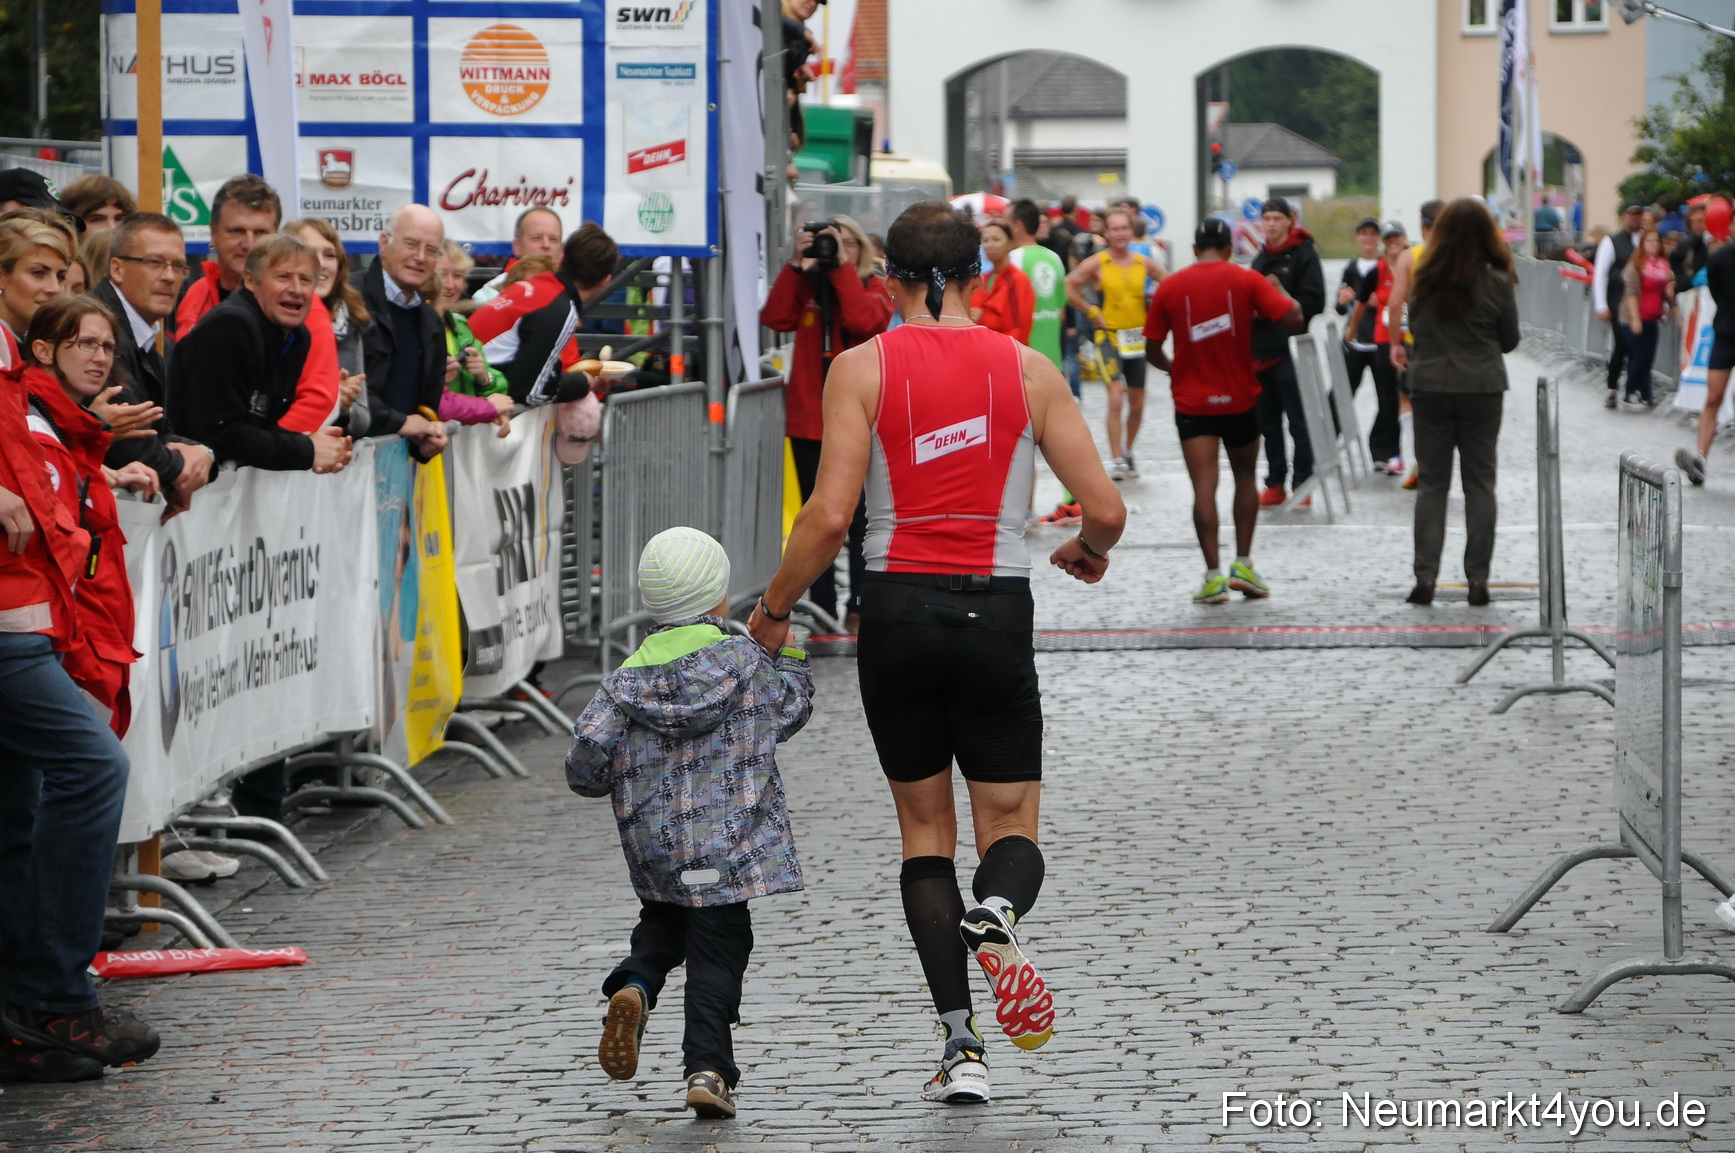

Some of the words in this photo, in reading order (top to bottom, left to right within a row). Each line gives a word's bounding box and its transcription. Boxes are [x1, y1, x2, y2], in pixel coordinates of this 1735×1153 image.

[616, 7, 671, 22] swn
[110, 54, 235, 75] NAHUS
[459, 66, 551, 80] WITTMANN
[309, 73, 352, 85] MAX
[359, 70, 406, 85] BÖGL
[485, 84, 525, 94] DRUCK
[470, 89, 541, 115] VERPACKUNG
[499, 94, 509, 104] &
[642, 148, 671, 166] DEHN
[438, 168, 574, 211] Charivari
[300, 197, 382, 210] eumarkter
[934, 428, 968, 451] DEHN
[732, 703, 768, 722] STREET
[670, 755, 707, 778] STREET
[733, 752, 768, 773] STREET
[669, 804, 707, 827] STREET
[106, 950, 163, 963] Audi
